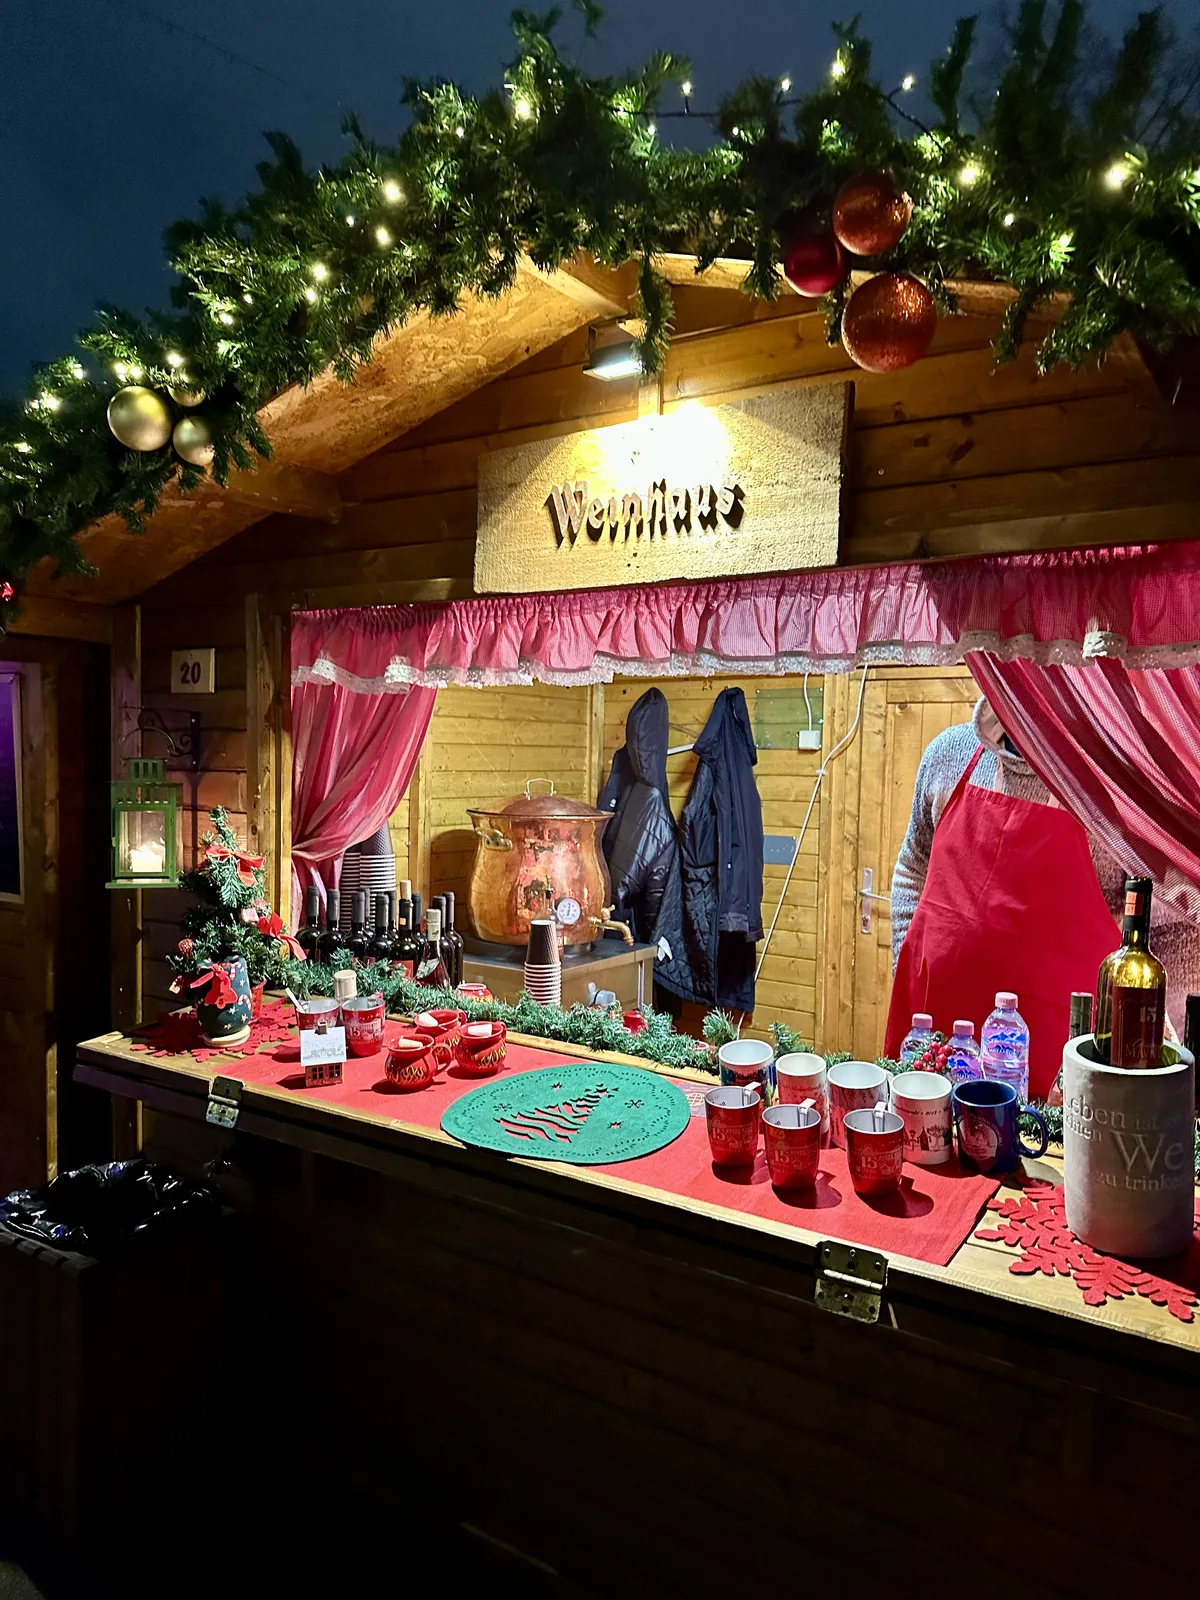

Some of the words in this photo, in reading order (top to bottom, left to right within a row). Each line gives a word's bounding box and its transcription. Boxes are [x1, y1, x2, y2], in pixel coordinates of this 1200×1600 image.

[545, 478, 744, 545] Weinhaus
[181, 662, 201, 684] 20
[1140, 1006, 1157, 1023] 15
[712, 1127, 726, 1141] 15
[774, 1149, 790, 1163] 15
[861, 1155, 878, 1169] 15
